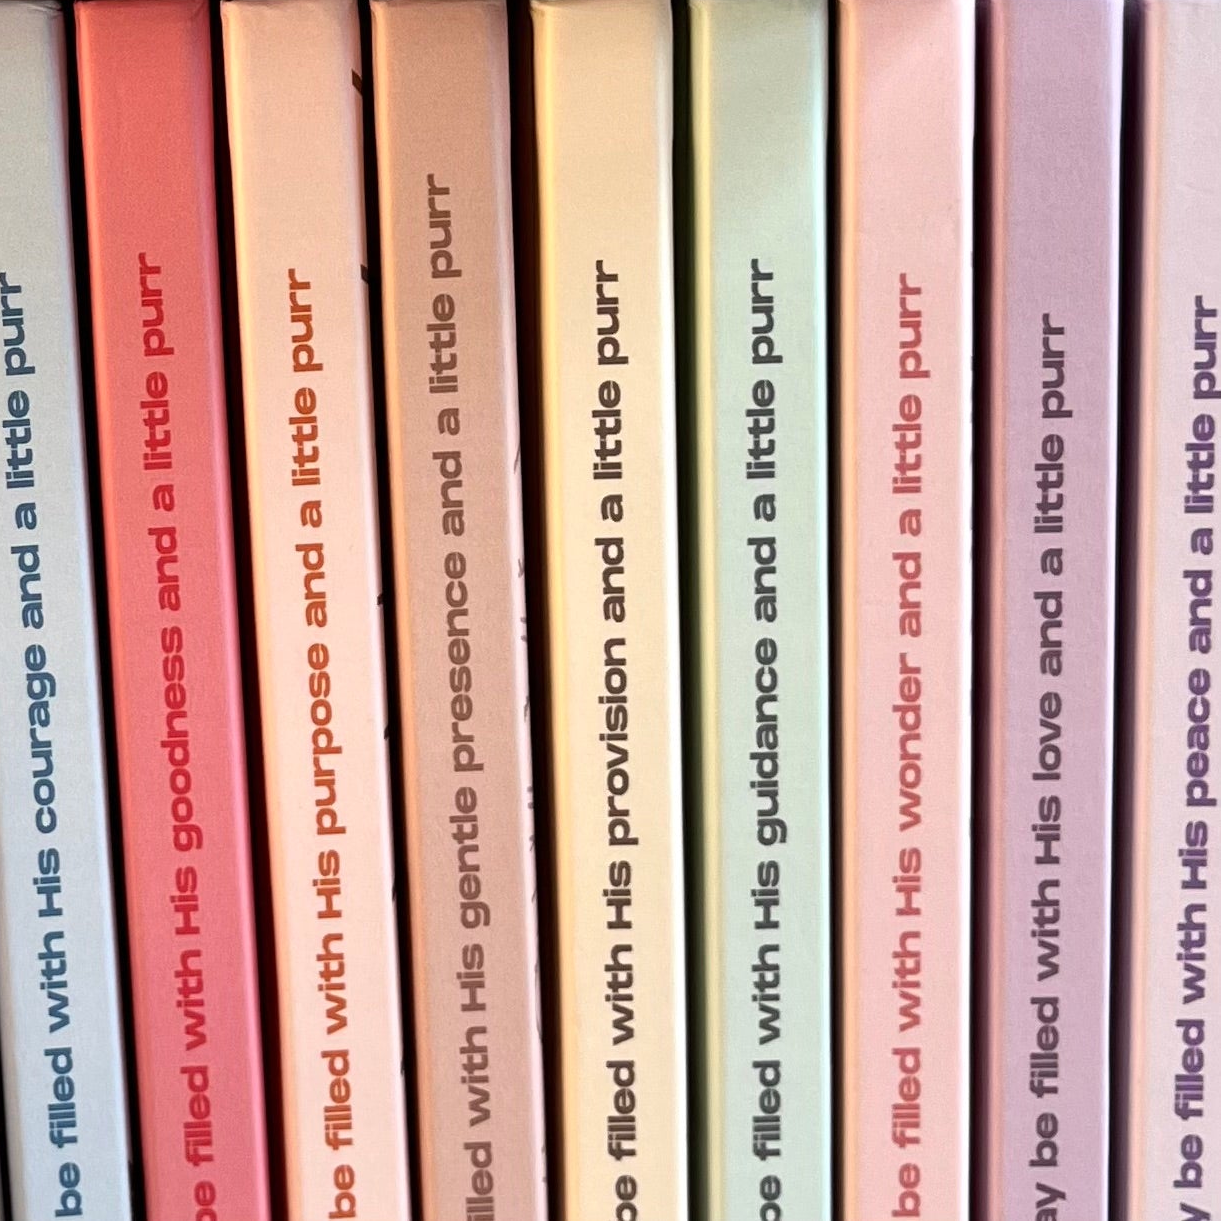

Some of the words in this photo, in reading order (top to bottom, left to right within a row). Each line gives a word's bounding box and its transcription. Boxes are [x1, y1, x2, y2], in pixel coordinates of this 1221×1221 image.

[427, 173, 462, 279] purr
[0, 271, 35, 376] purr
[138, 251, 174, 357] purr
[288, 268, 323, 372] purr
[427, 293, 458, 393] little
[596, 259, 628, 365] purr
[751, 258, 783, 364] purr
[899, 272, 930, 379] purr
[1193, 294, 1221, 399] purr
[1042, 312, 1073, 418] purr
[2, 389, 34, 489] little
[140, 370, 172, 470] little
[289, 387, 320, 486] little
[438, 407, 460, 436] a
[592, 380, 622, 480] little
[746, 379, 775, 479] little
[892, 394, 922, 494] little
[1184, 413, 1215, 513] little
[15, 501, 37, 530] a
[153, 483, 175, 512] a
[300, 499, 322, 528] a
[432, 450, 465, 536] and
[601, 493, 623, 522] a
[754, 493, 776, 522] a
[900, 508, 921, 536] a
[1034, 433, 1064, 533] little
[11, 544, 44, 629] and
[147, 525, 181, 611] and
[295, 542, 327, 627] and
[595, 536, 625, 622] and
[747, 536, 777, 622] and
[1041, 547, 1063, 576] a
[1191, 527, 1213, 555] a
[892, 551, 922, 637] and
[1034, 590, 1063, 676] and
[1183, 569, 1212, 654] and
[444, 551, 484, 772] presence
[25, 643, 57, 834] courage
[160, 625, 203, 852] goodness
[308, 642, 346, 835] purpose
[598, 637, 639, 846] provision
[750, 637, 787, 846] guidance
[892, 652, 921, 832] wonder
[1032, 691, 1062, 780] love
[1186, 668, 1217, 807] peace
[449, 786, 490, 929] gentle
[1032, 794, 1061, 865] His
[1178, 820, 1207, 889] His
[33, 847, 63, 917] His
[169, 865, 200, 935] His
[313, 849, 342, 919] His
[603, 860, 632, 929] His
[751, 860, 779, 929] His
[892, 847, 921, 916] His
[1031, 878, 1060, 981] with
[38, 930, 70, 1033] with
[174, 948, 206, 1051] with
[316, 932, 347, 1035] with
[456, 943, 486, 1012] His
[604, 943, 634, 1045] with
[752, 943, 780, 1045] with
[892, 930, 921, 1032] with
[1177, 903, 1207, 1004] with
[44, 1046, 77, 1148] filled
[459, 1025, 490, 1127] with
[1029, 996, 1059, 1098] filled
[1174, 1018, 1204, 1120] filled
[180, 1064, 214, 1167] filled
[321, 1049, 353, 1151] filled
[606, 1059, 636, 1161] filled
[752, 1059, 781, 1161] filled
[892, 1047, 921, 1149] filled
[1029, 1112, 1058, 1167] be
[55, 1162, 82, 1217] be
[329, 1164, 356, 1219] be
[464, 1141, 494, 1221] illed
[892, 1163, 921, 1217] be
[1173, 1134, 1203, 1188] be
